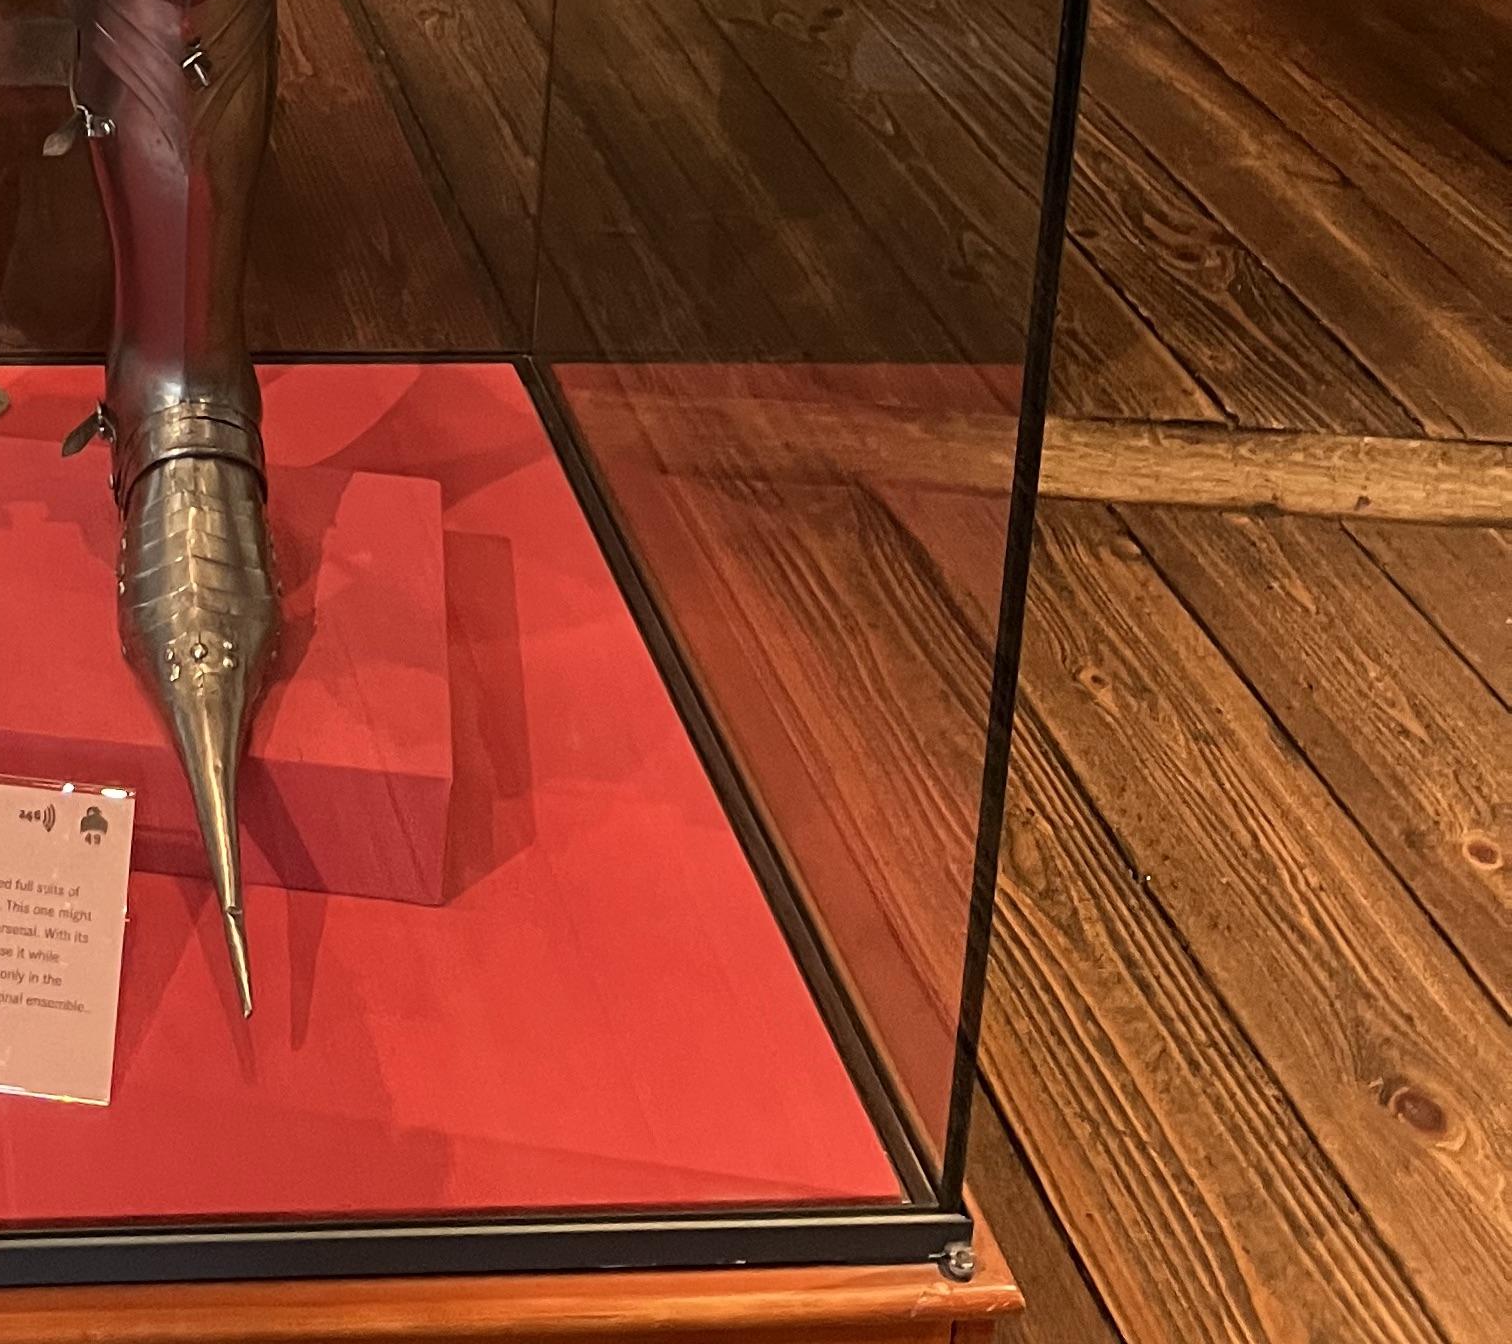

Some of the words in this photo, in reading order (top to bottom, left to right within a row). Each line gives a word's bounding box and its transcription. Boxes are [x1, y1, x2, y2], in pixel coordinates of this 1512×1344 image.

[14, 878, 33, 891] full
[68, 885, 80, 897] of
[6, 899, 29, 914] This
[32, 905, 54, 917] one
[58, 907, 91, 923] might
[44, 927, 70, 940] With
[73, 930, 88, 943] its
[16, 946, 24, 958] it
[28, 949, 60, 963] while
[0, 968, 25, 984] only
[28, 970, 39, 983] in
[42, 973, 62, 986] the
